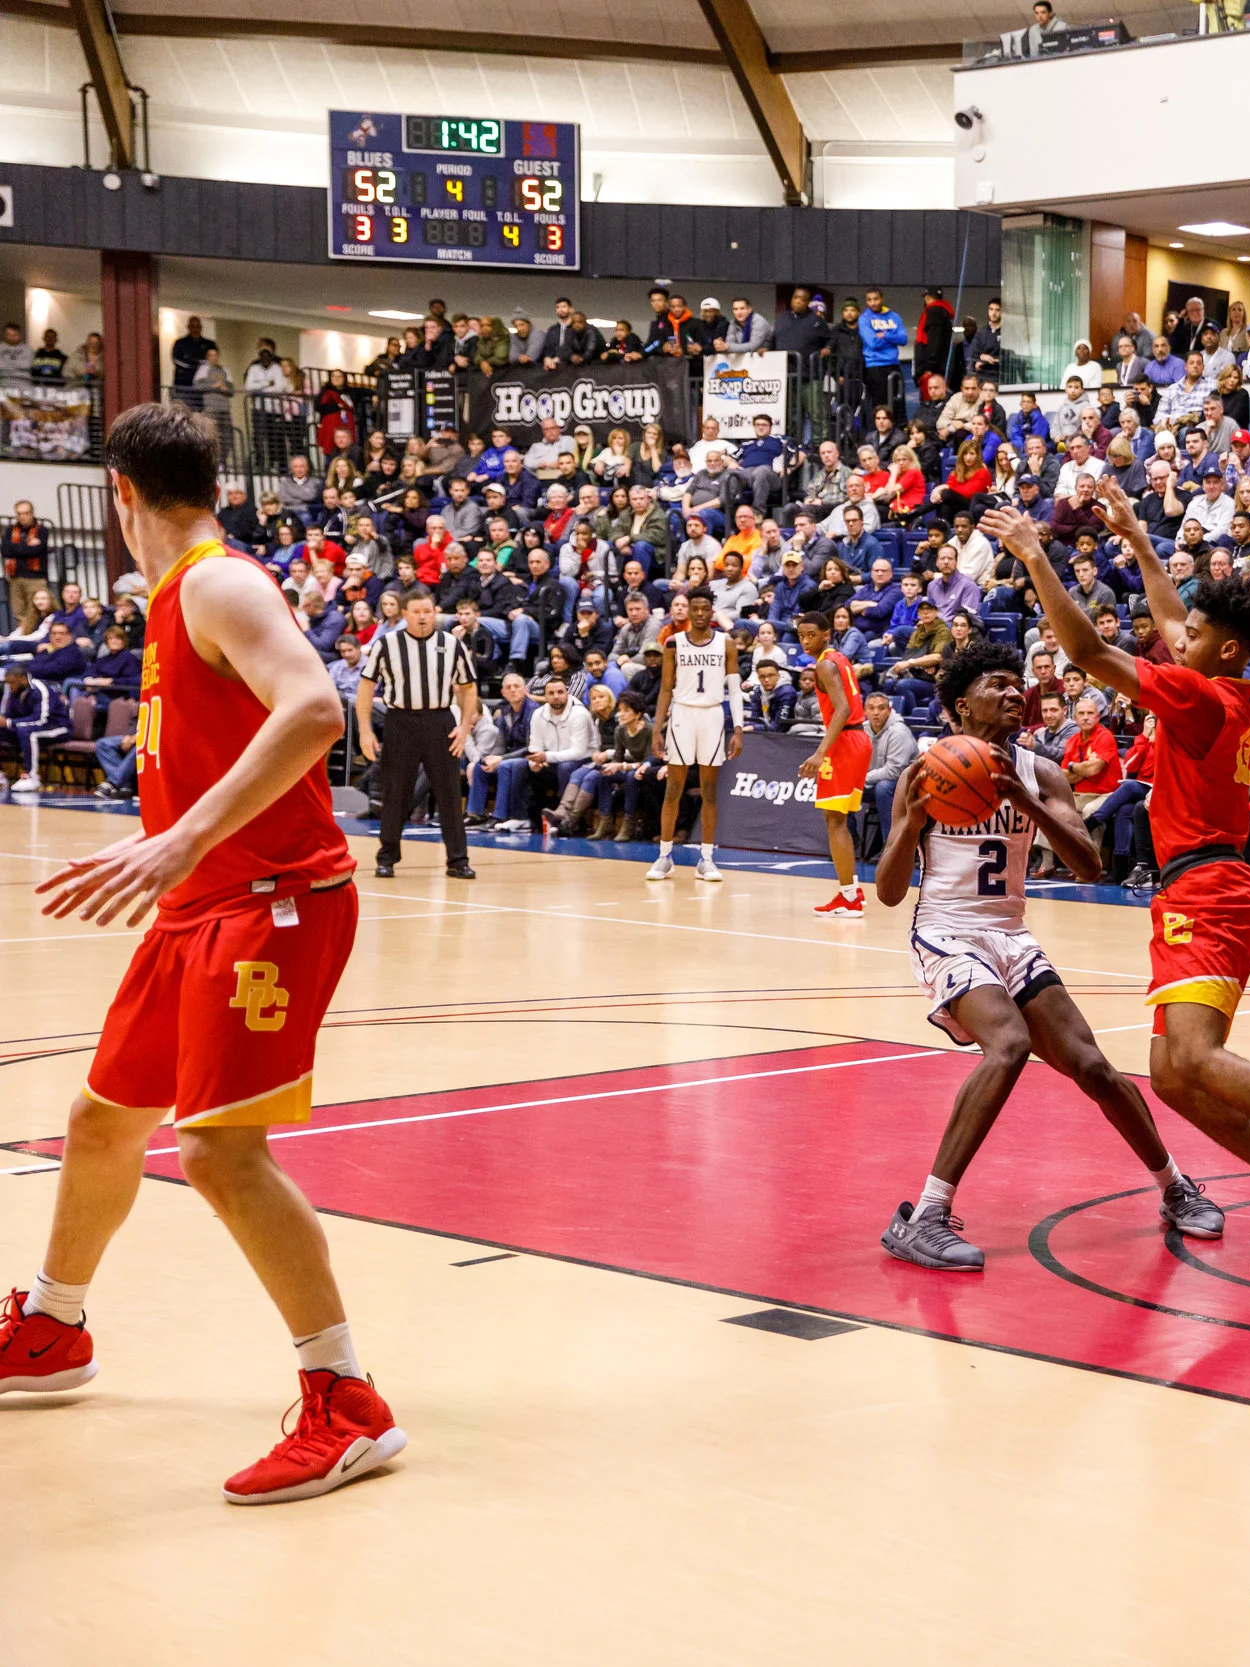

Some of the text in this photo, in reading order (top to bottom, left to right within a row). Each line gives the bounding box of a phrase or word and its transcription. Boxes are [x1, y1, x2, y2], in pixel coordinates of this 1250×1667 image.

[441, 120, 499, 153] 1:42
[347, 151, 393, 168] BLUES
[436, 163, 473, 177] PERIOD
[513, 159, 561, 177] GUEST
[354, 170, 396, 203] 52
[446, 179, 463, 202] 4
[521, 179, 562, 212] 52
[341, 203, 375, 216] FOULS
[420, 207, 488, 222] PLAYER FOUL
[533, 213, 566, 225] FOULS
[356, 215, 372, 241] 3
[392, 217, 408, 243] 3
[503, 225, 520, 247] 4
[547, 225, 562, 250] 3
[342, 244, 375, 256] SCORE
[437, 248, 473, 261] MATCH
[533, 253, 566, 265] SCORE
[708, 378, 781, 396] Hoop Group
[494, 383, 661, 427] Hoop Group
[680, 654, 723, 667] RANNEY
[696, 670, 705, 693] 1
[730, 772, 795, 805] Hoop
[977, 840, 1008, 896] 2
